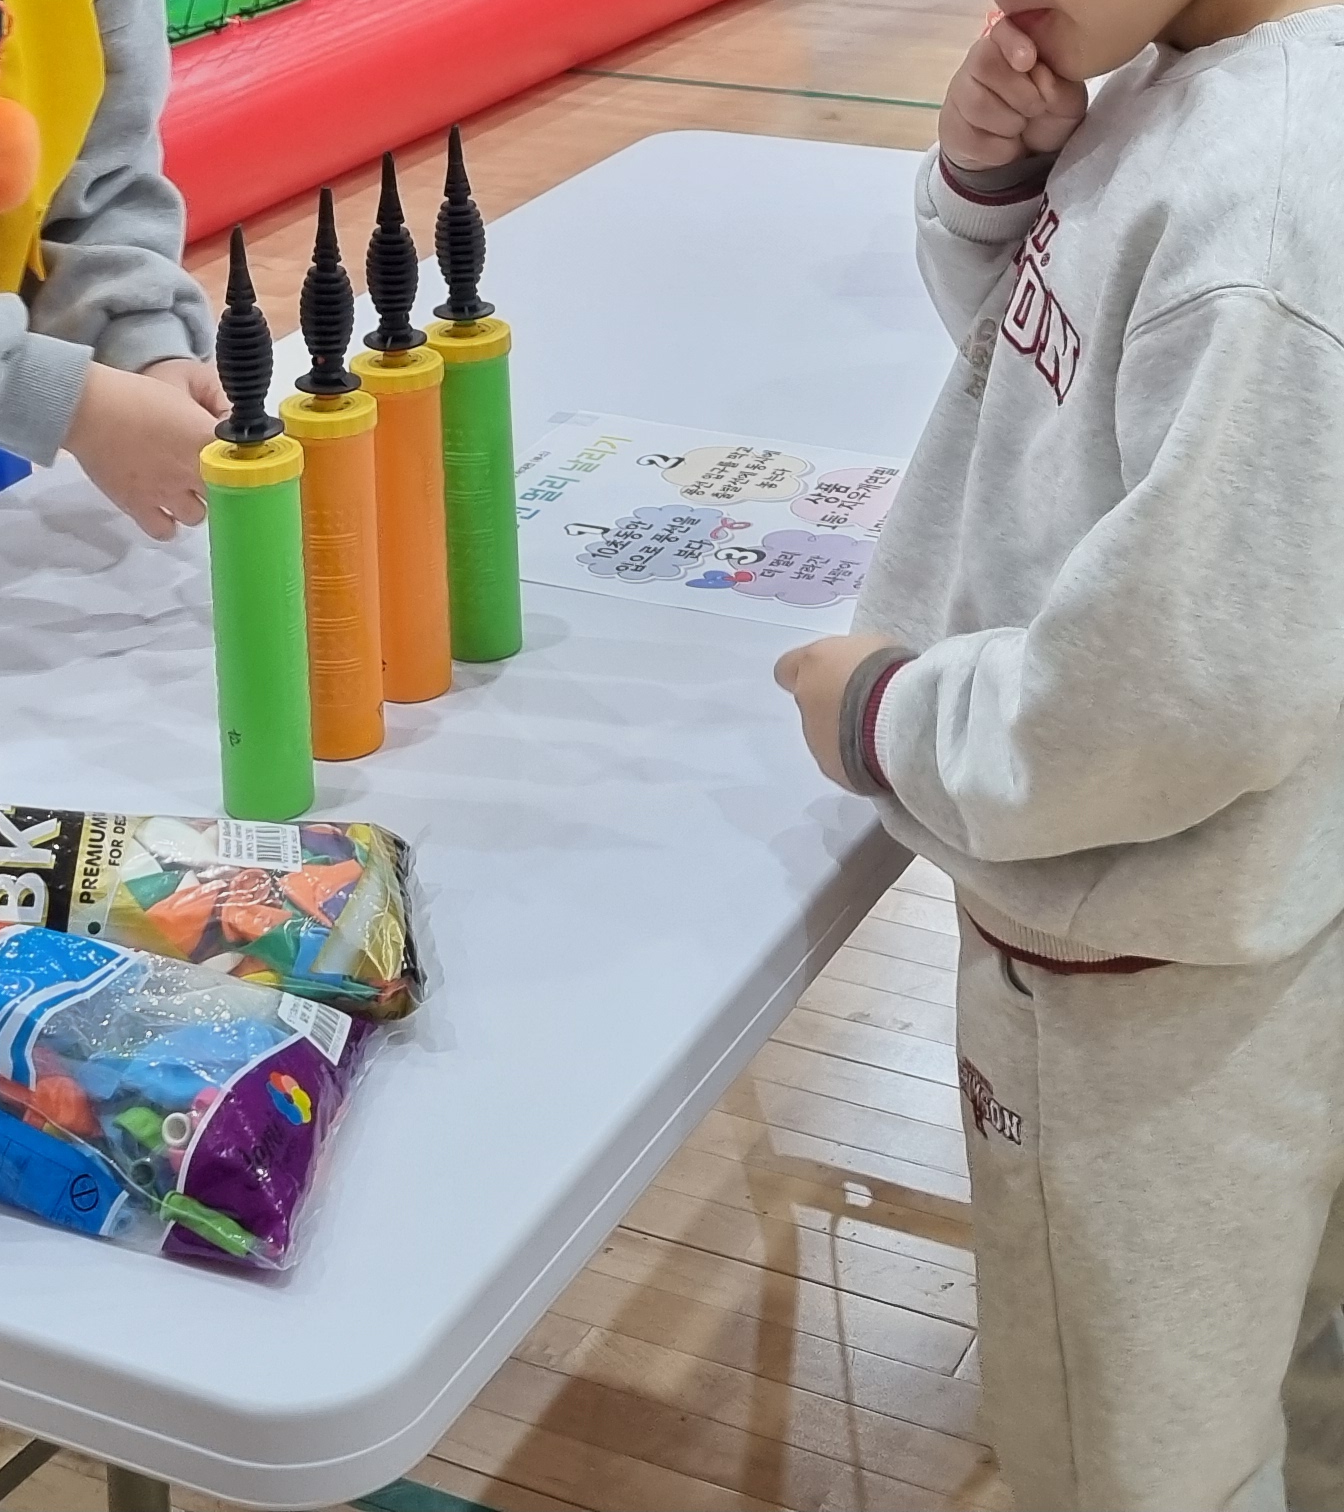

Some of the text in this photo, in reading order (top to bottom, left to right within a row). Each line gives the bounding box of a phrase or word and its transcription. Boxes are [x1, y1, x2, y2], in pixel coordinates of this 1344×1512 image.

[519, 474, 580, 502] 멀리
[559, 435, 633, 473] 날리기
[636, 453, 686, 470] 2
[804, 481, 852, 505] 상품
[564, 522, 611, 536] 1
[615, 516, 701, 573] 입으로 풍선을
[673, 539, 714, 560] 분다
[714, 546, 767, 565] 3
[759, 551, 803, 578] 더 멀리
[108, 839, 124, 867] FOR
